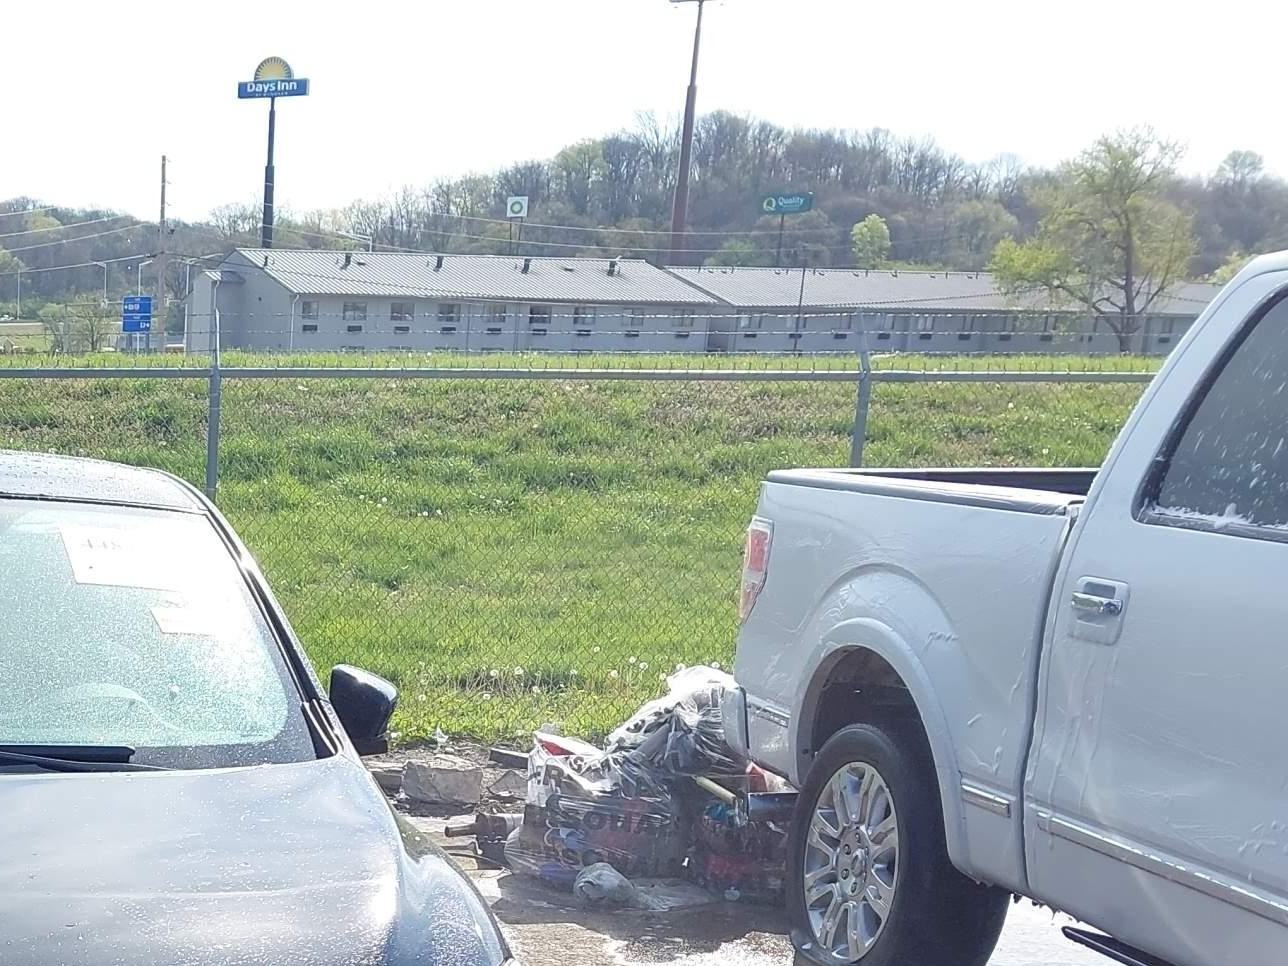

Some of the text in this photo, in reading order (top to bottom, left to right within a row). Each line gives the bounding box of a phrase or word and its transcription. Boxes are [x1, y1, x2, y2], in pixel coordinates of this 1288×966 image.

[247, 80, 297, 93] Days Inn
[778, 196, 804, 207] Quality
